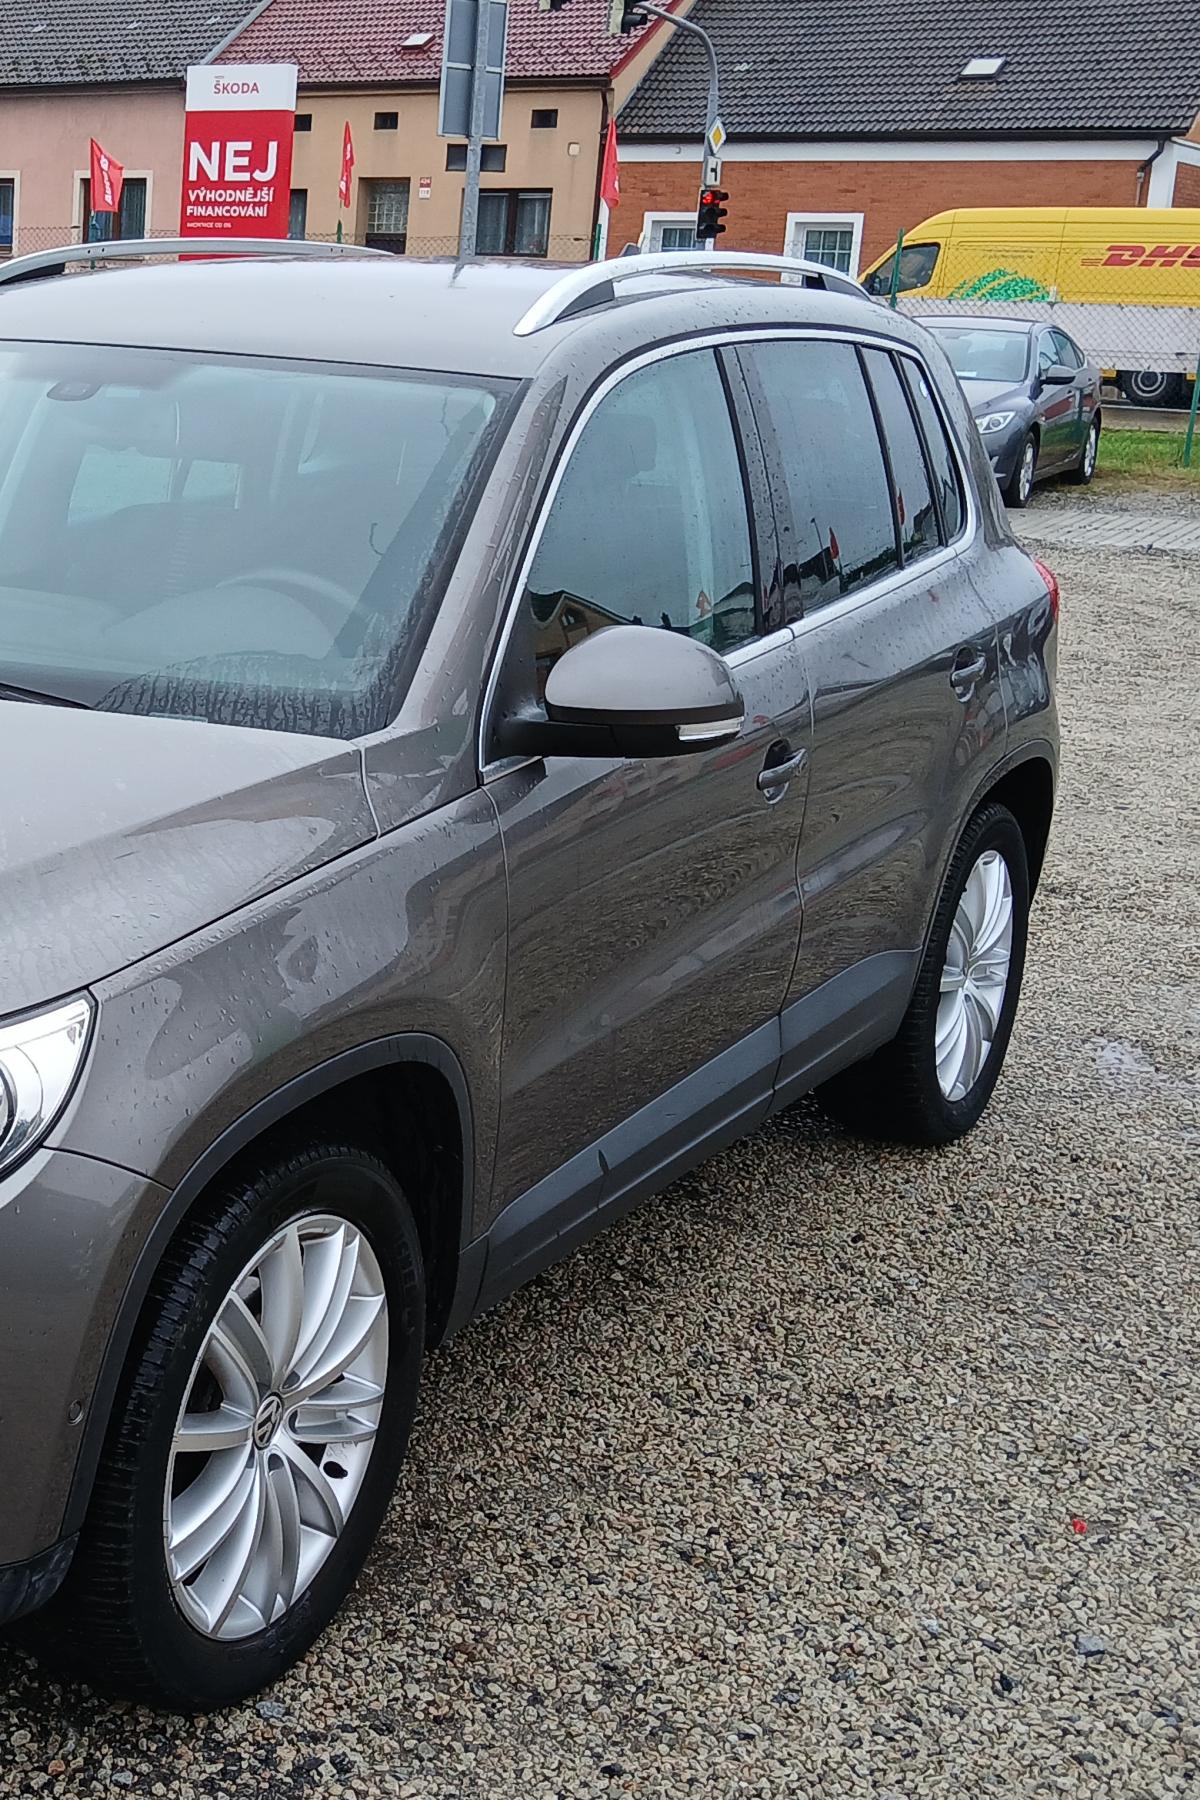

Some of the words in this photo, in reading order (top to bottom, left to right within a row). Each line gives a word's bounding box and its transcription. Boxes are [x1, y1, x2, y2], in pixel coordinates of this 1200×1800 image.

[213, 79, 259, 94] ŠKODA
[188, 141, 278, 182] NEJ
[188, 187, 274, 202] VÝHODNĚJŠÍ
[186, 203, 268, 217] FINANCOVÁNÍ
